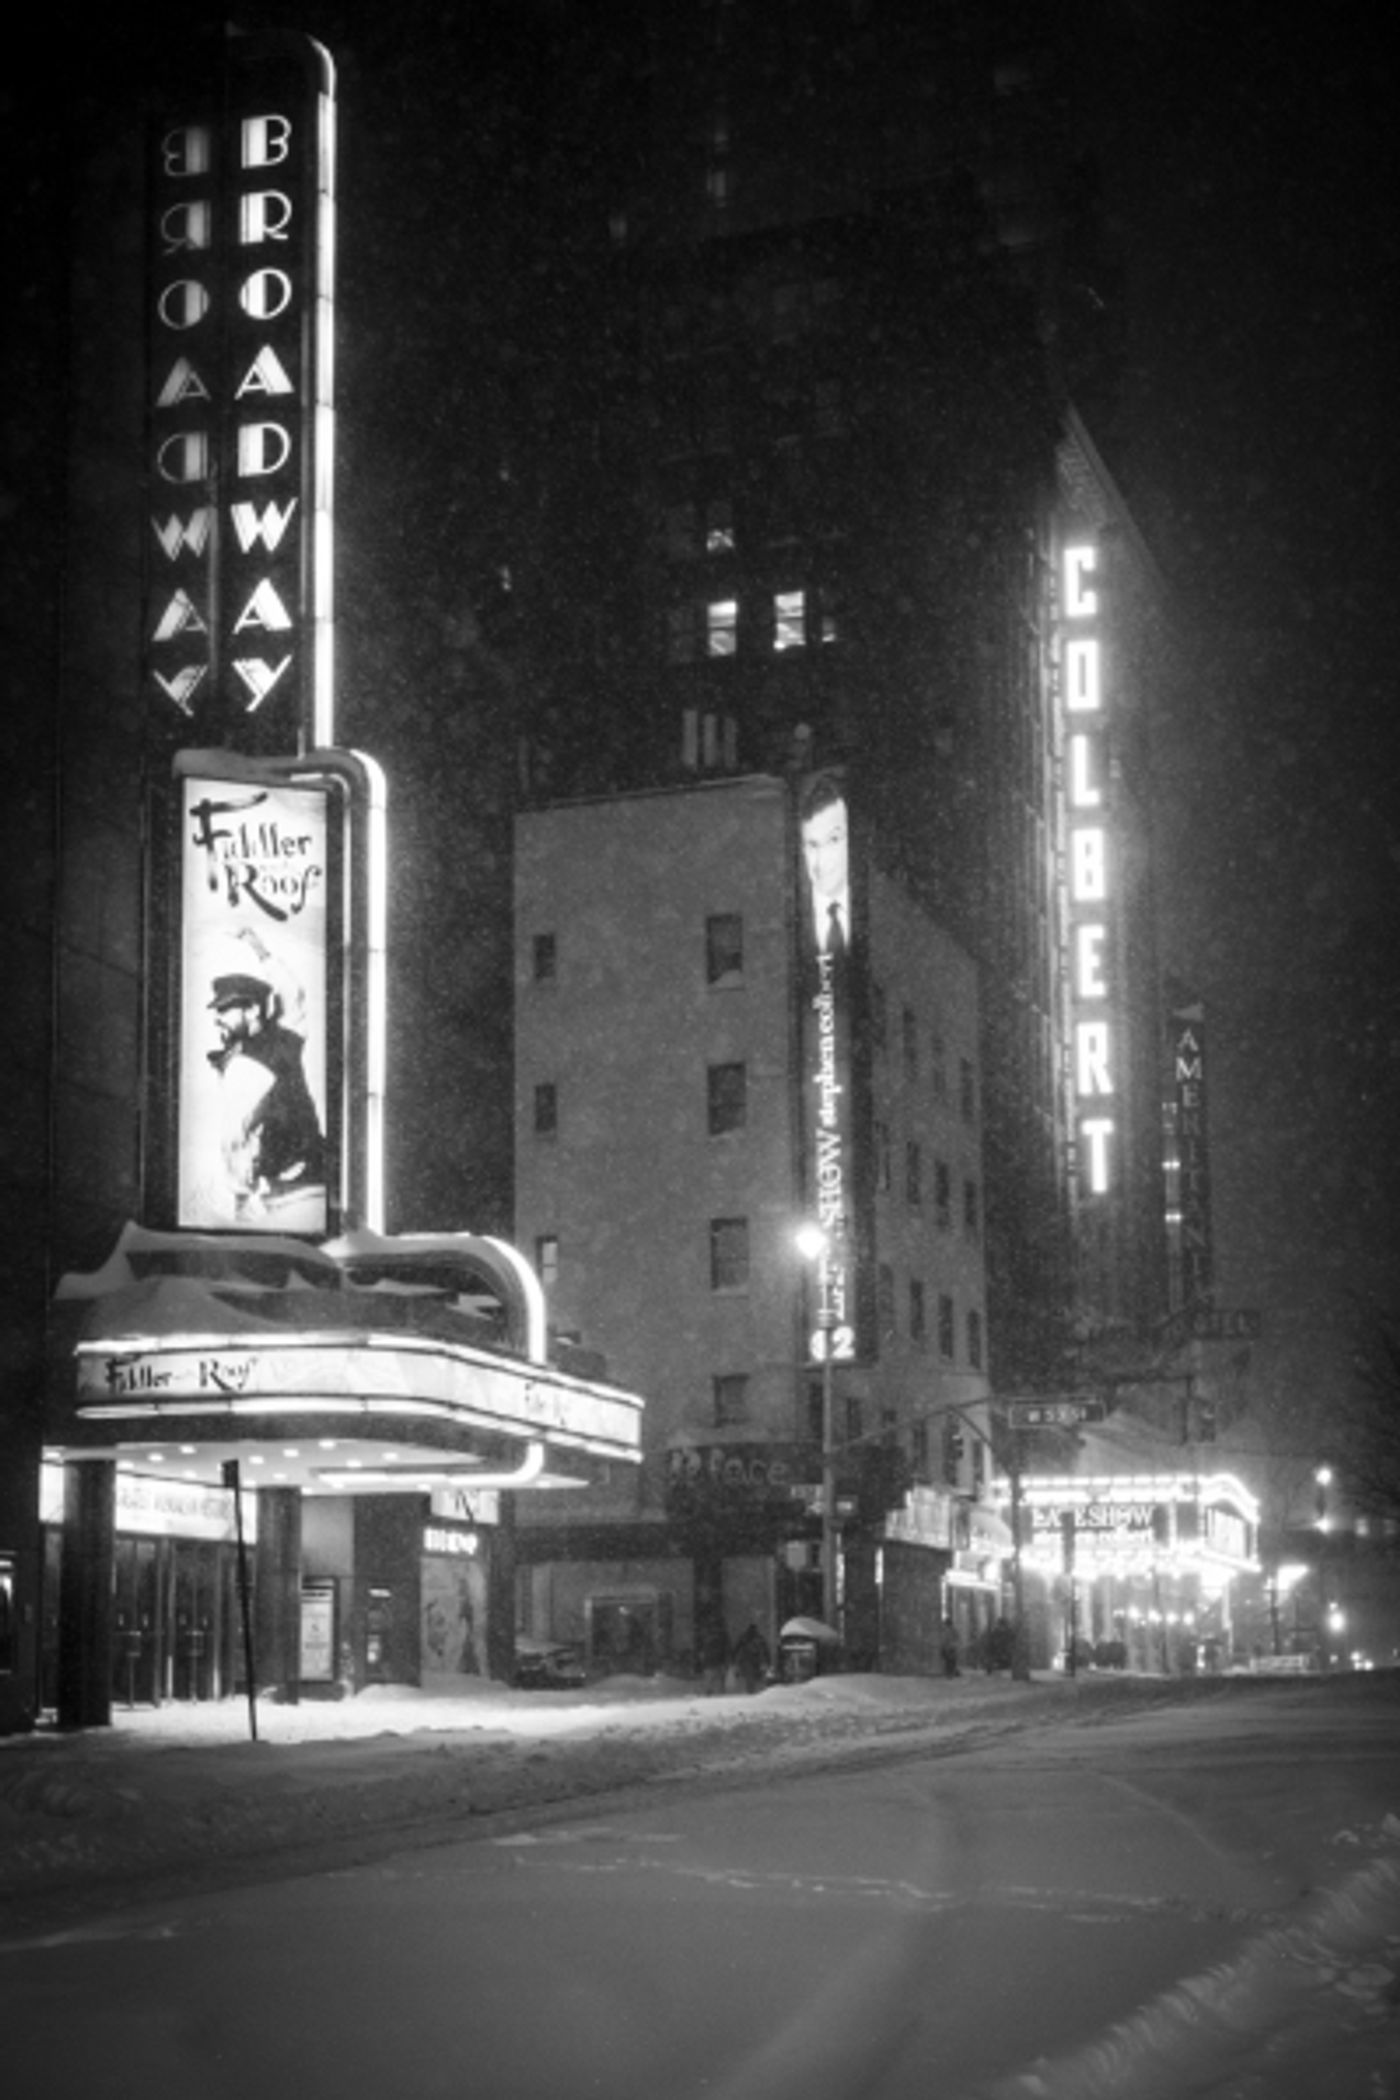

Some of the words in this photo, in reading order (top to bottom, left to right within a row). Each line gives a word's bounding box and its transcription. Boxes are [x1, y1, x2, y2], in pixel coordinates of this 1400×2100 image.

[230, 114, 298, 712] BROADWAY
[1063, 545, 1113, 1192] COLBERT
[1032, 1506, 1087, 1527] LAE
